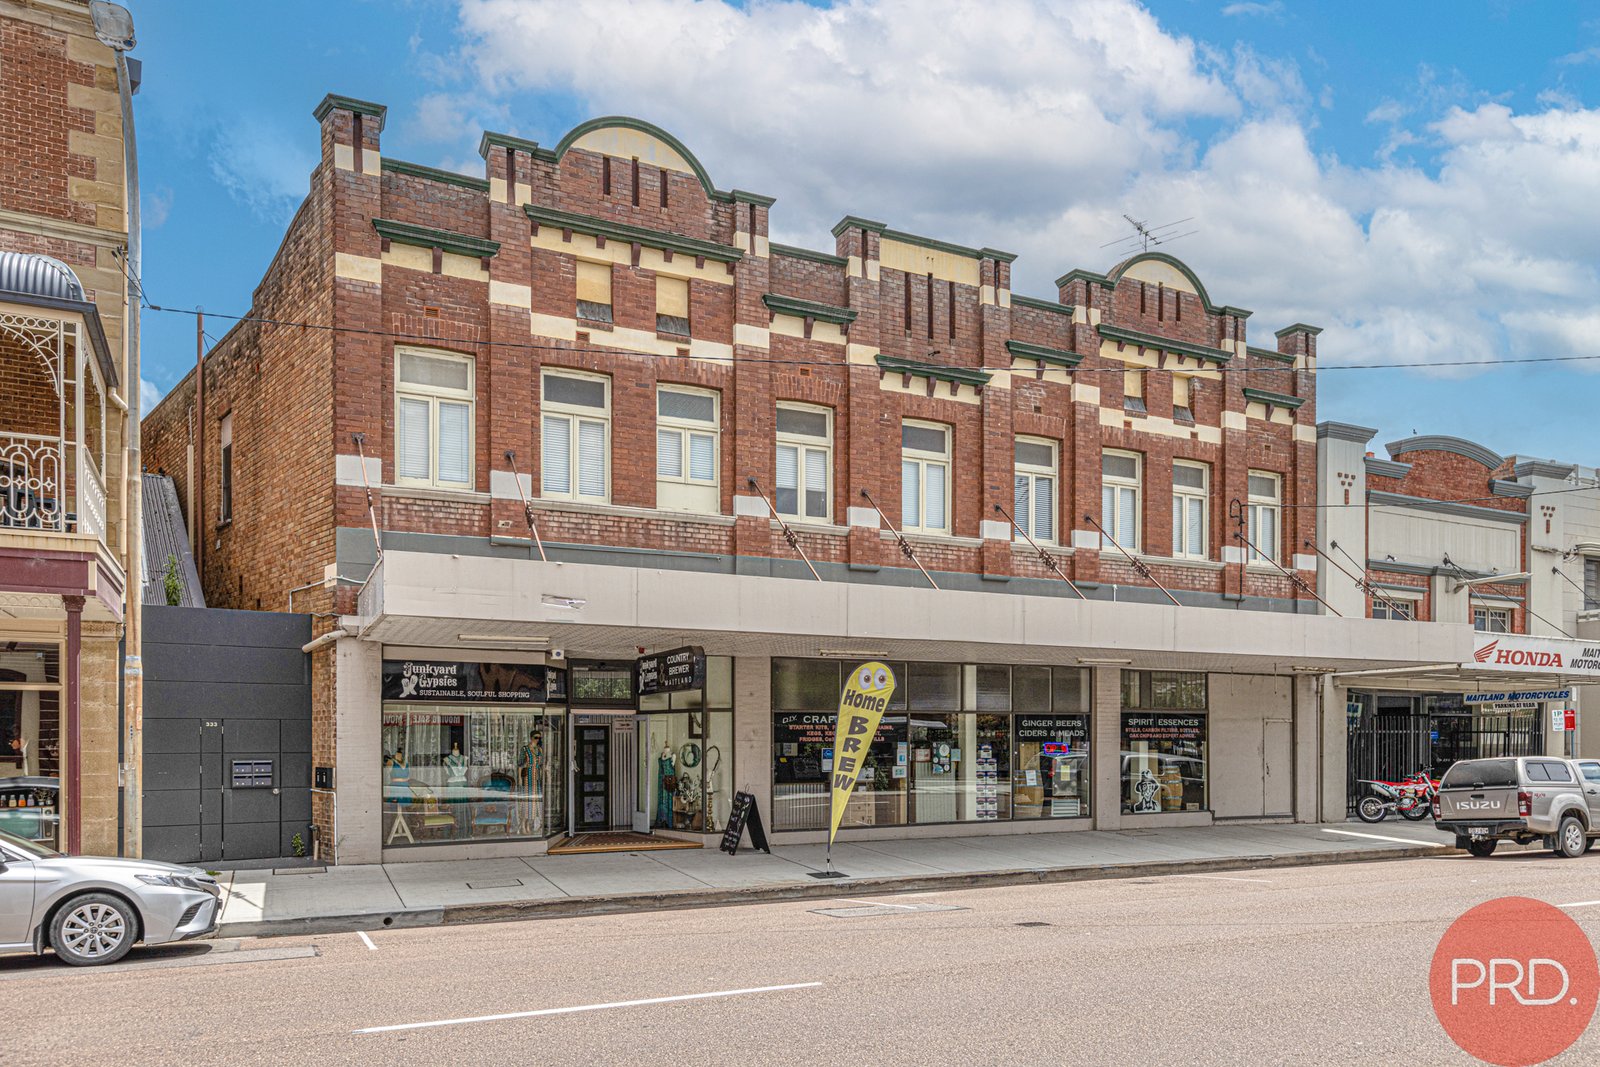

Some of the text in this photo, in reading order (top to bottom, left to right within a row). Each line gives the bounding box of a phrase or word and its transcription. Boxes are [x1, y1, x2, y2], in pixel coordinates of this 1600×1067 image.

[666, 652, 690, 665] COUNTRY
[1495, 649, 1563, 667] HONDA
[403, 662, 457, 677] Junkyard
[668, 664, 690, 675] BREWER
[419, 674, 457, 688] Gypsies
[664, 675, 692, 686] MAITLAND
[419, 689, 466, 697] SUSTAINABLE,
[467, 690, 497, 698] SOULFUL
[1465, 690, 1570, 702] MAITLAND MOTORCYCLES
[843, 689, 886, 713] Home
[1128, 718, 1153, 726] SPIRIT
[1456, 800, 1501, 810] ISUZU
